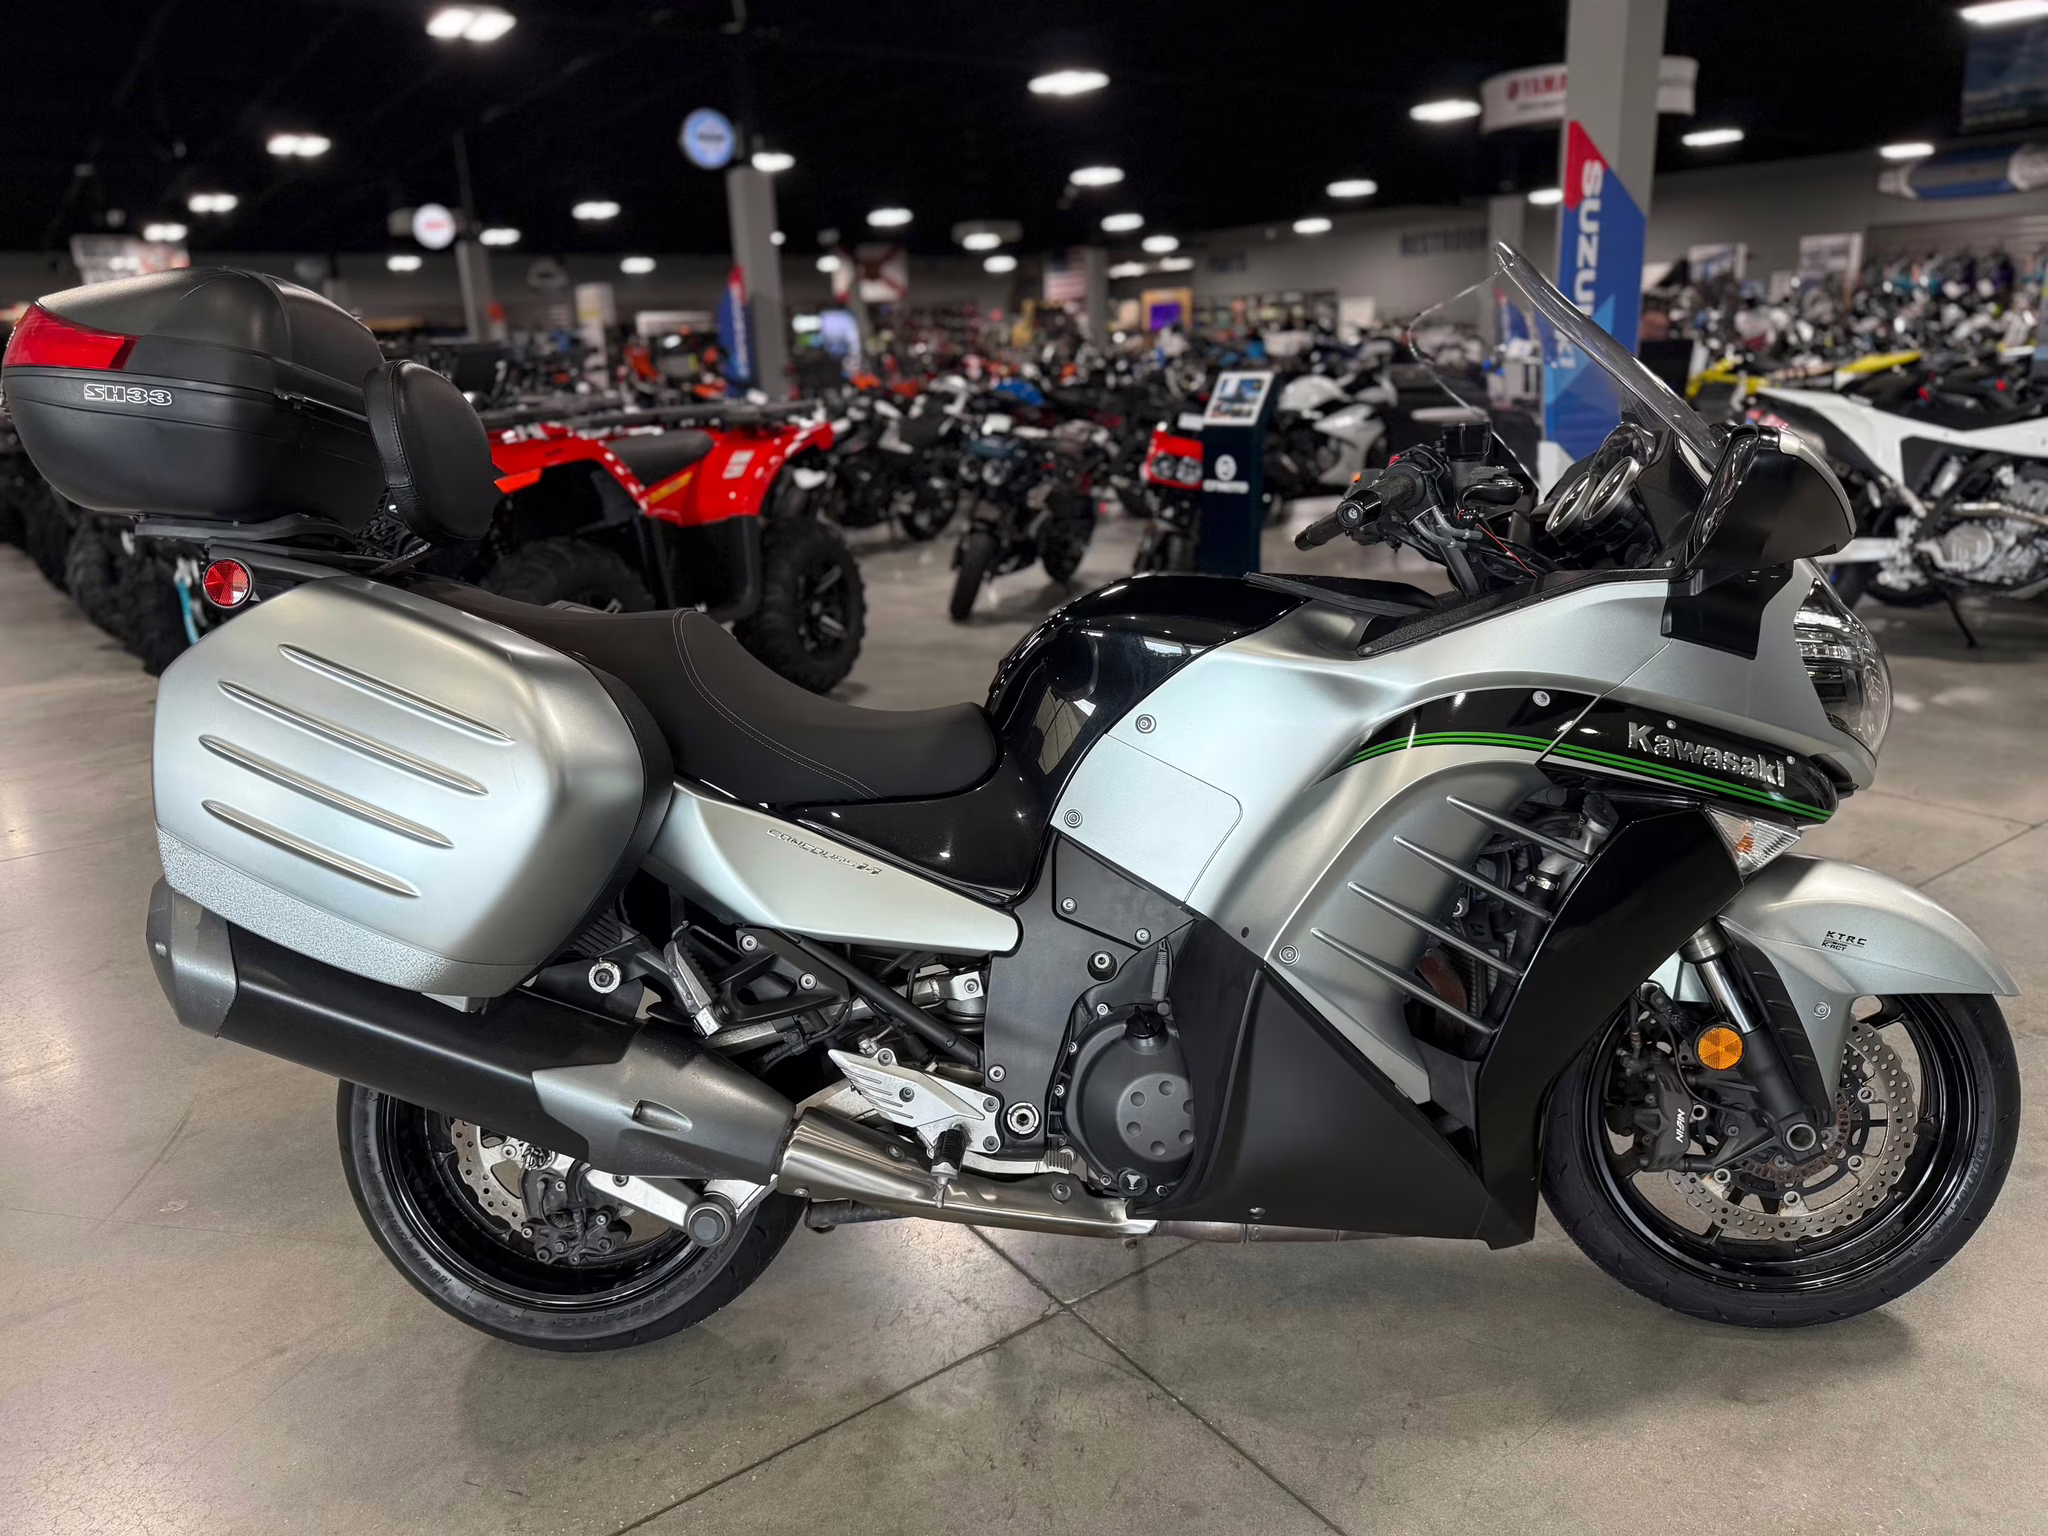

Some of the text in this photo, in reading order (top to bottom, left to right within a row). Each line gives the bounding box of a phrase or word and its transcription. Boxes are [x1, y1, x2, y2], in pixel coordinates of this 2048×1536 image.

[84, 382, 173, 406] SH33
[1628, 721, 1785, 787] Kawasaki
[1826, 930, 1867, 946] KTRC
